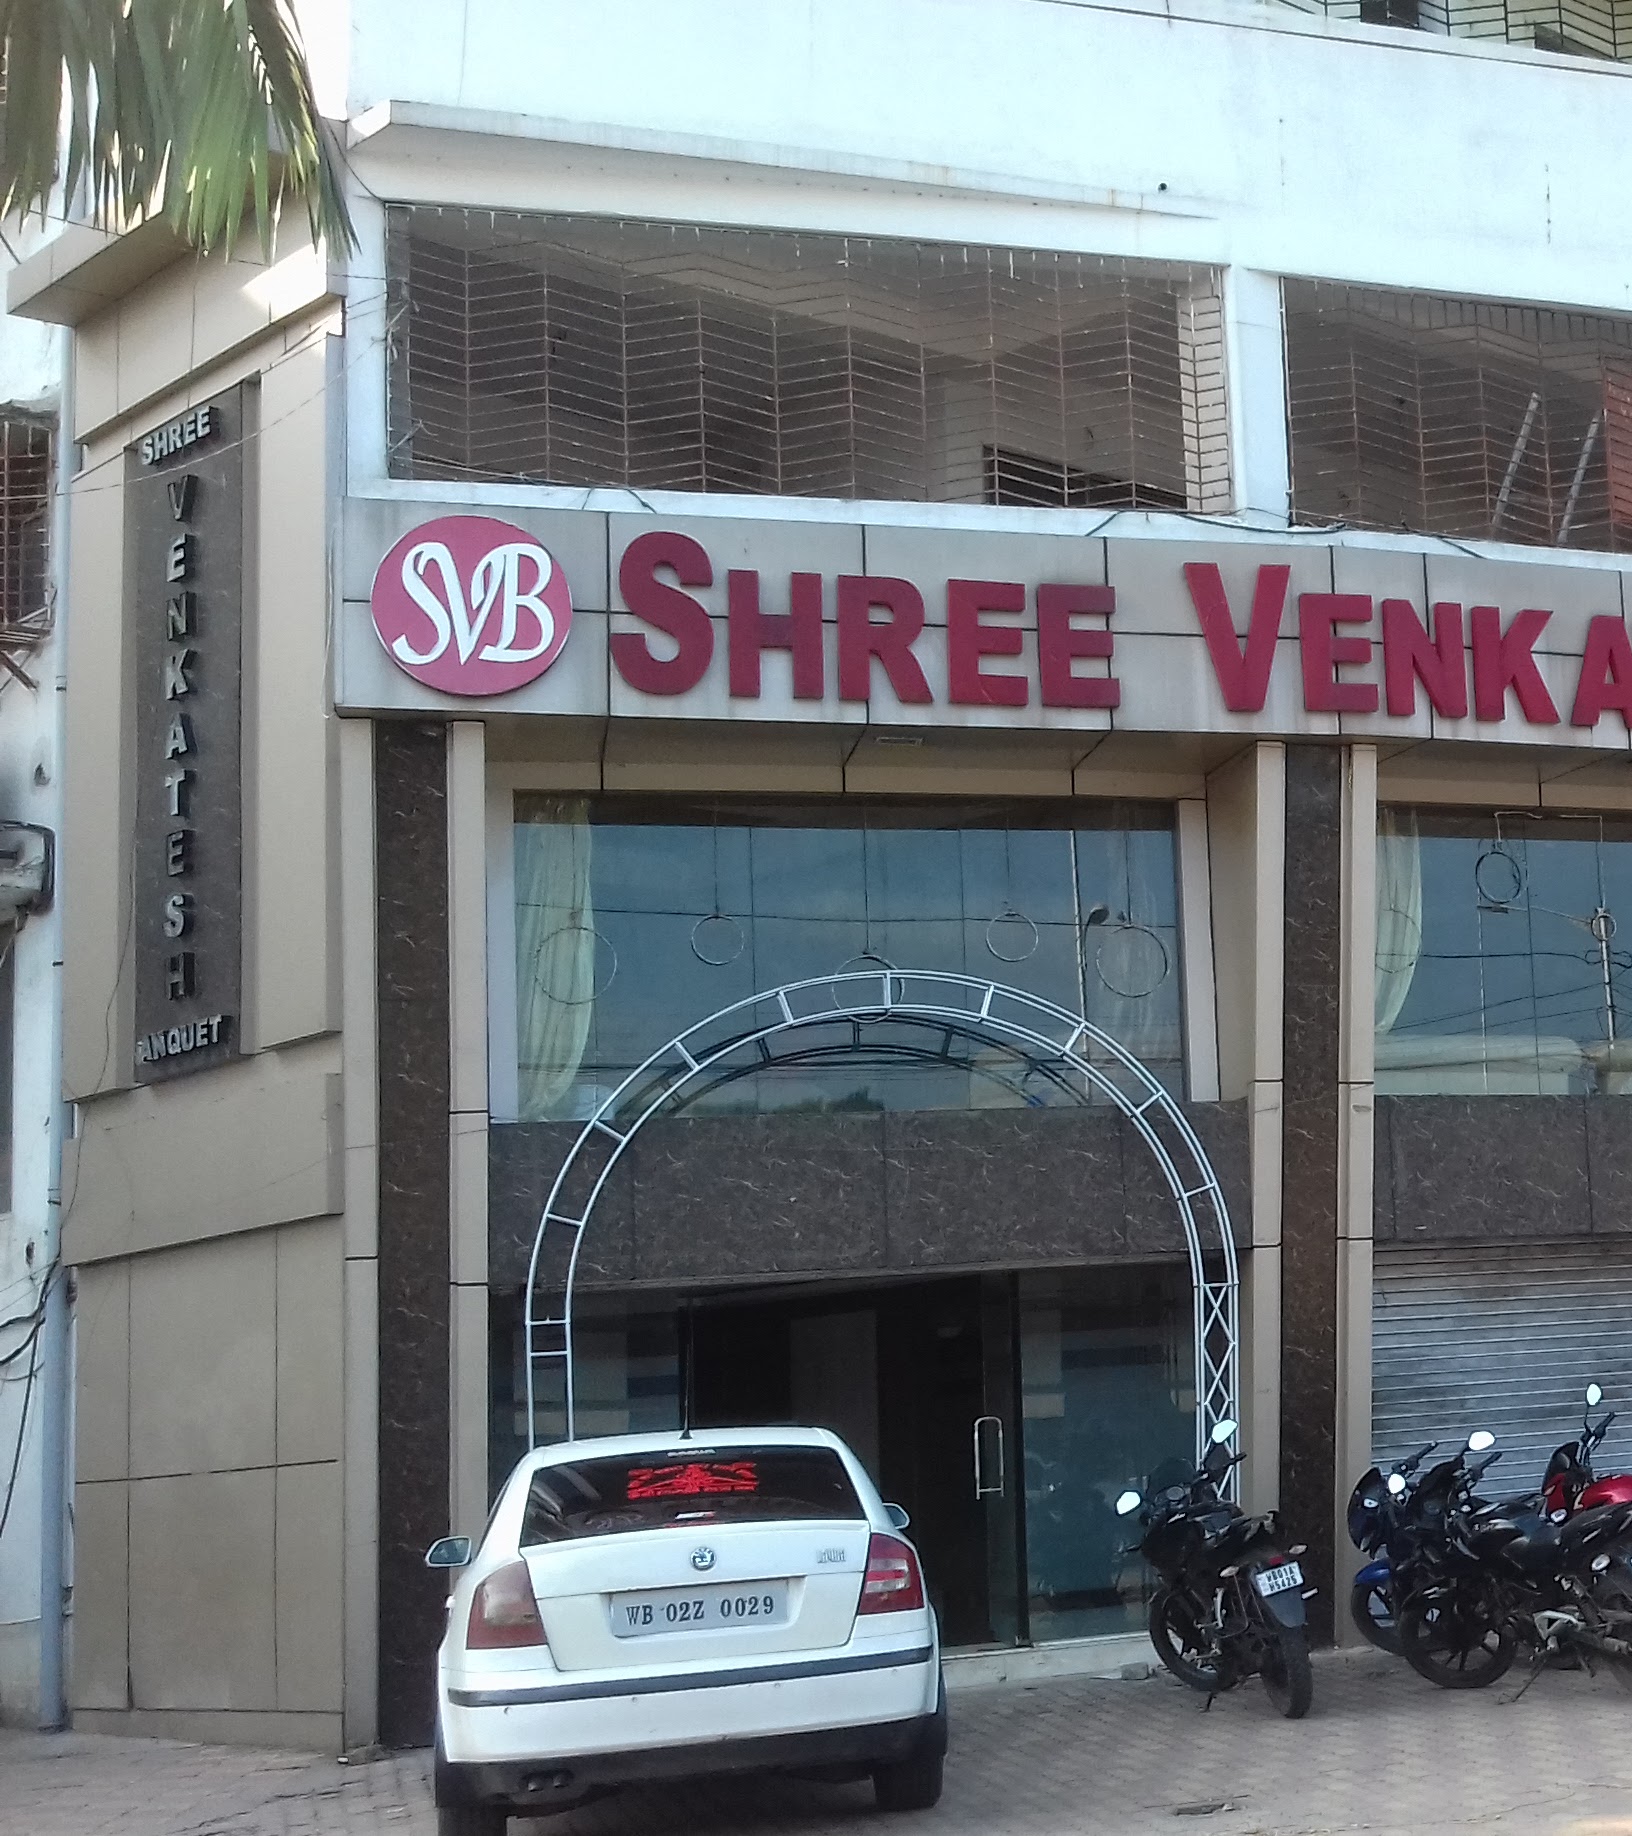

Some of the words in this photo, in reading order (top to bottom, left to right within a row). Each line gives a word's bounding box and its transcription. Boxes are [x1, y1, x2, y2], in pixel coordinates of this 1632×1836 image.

[142, 406, 212, 466] SHREE
[392, 541, 555, 665] SVB
[610, 531, 1121, 708] SHREE
[163, 474, 194, 1000] VENKATESH
[625, 1604, 653, 1626] WB
[666, 1600, 705, 1622] 02Z
[720, 1595, 774, 1617] 0029
